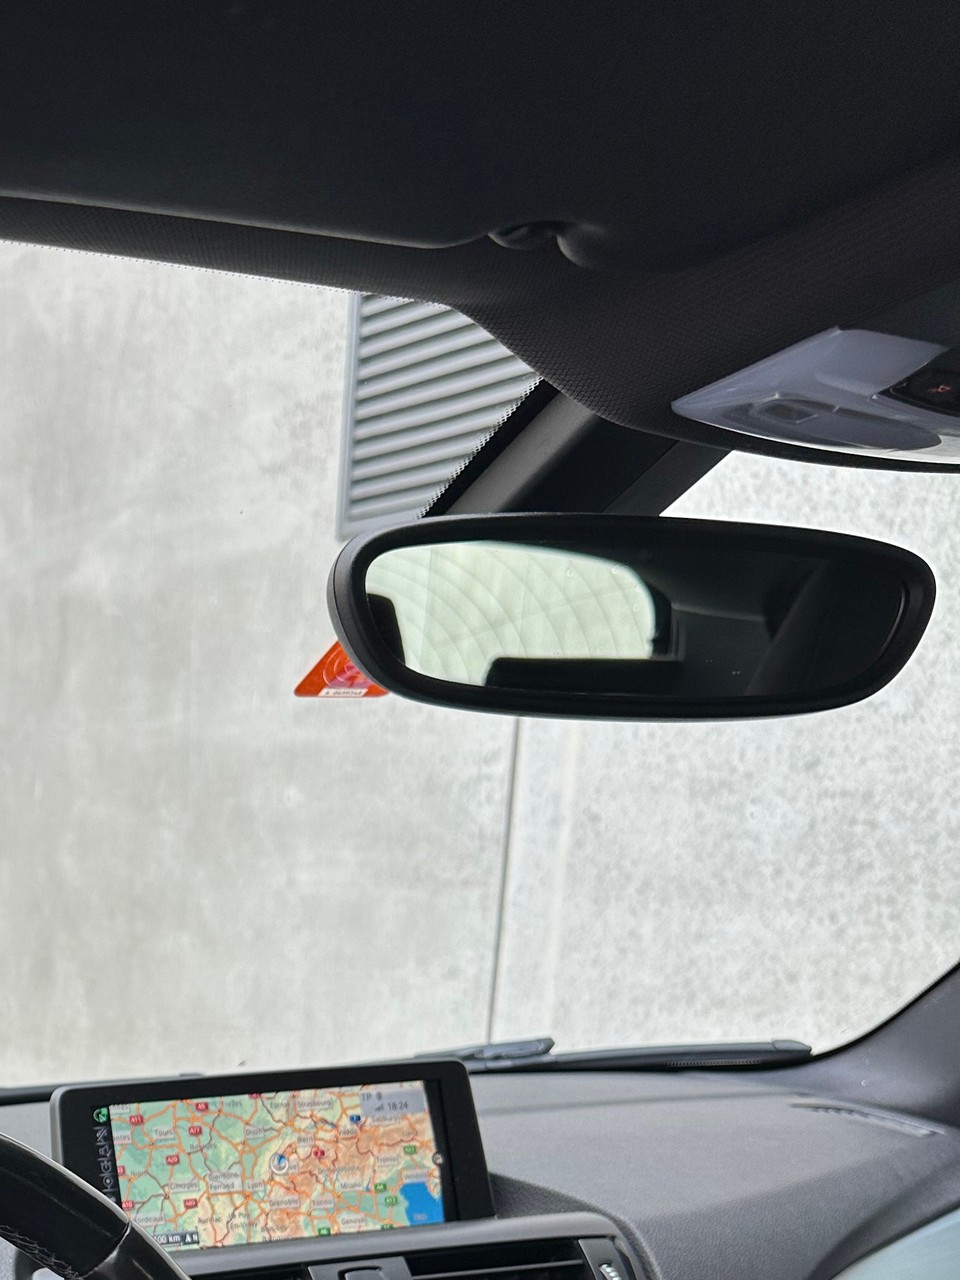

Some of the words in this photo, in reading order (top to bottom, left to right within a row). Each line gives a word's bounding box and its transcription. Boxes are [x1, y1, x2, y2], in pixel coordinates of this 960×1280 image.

[387, 1101, 408, 1111] 18:24
[247, 1181, 263, 1191] Lyon
[168, 1234, 180, 1243] km
